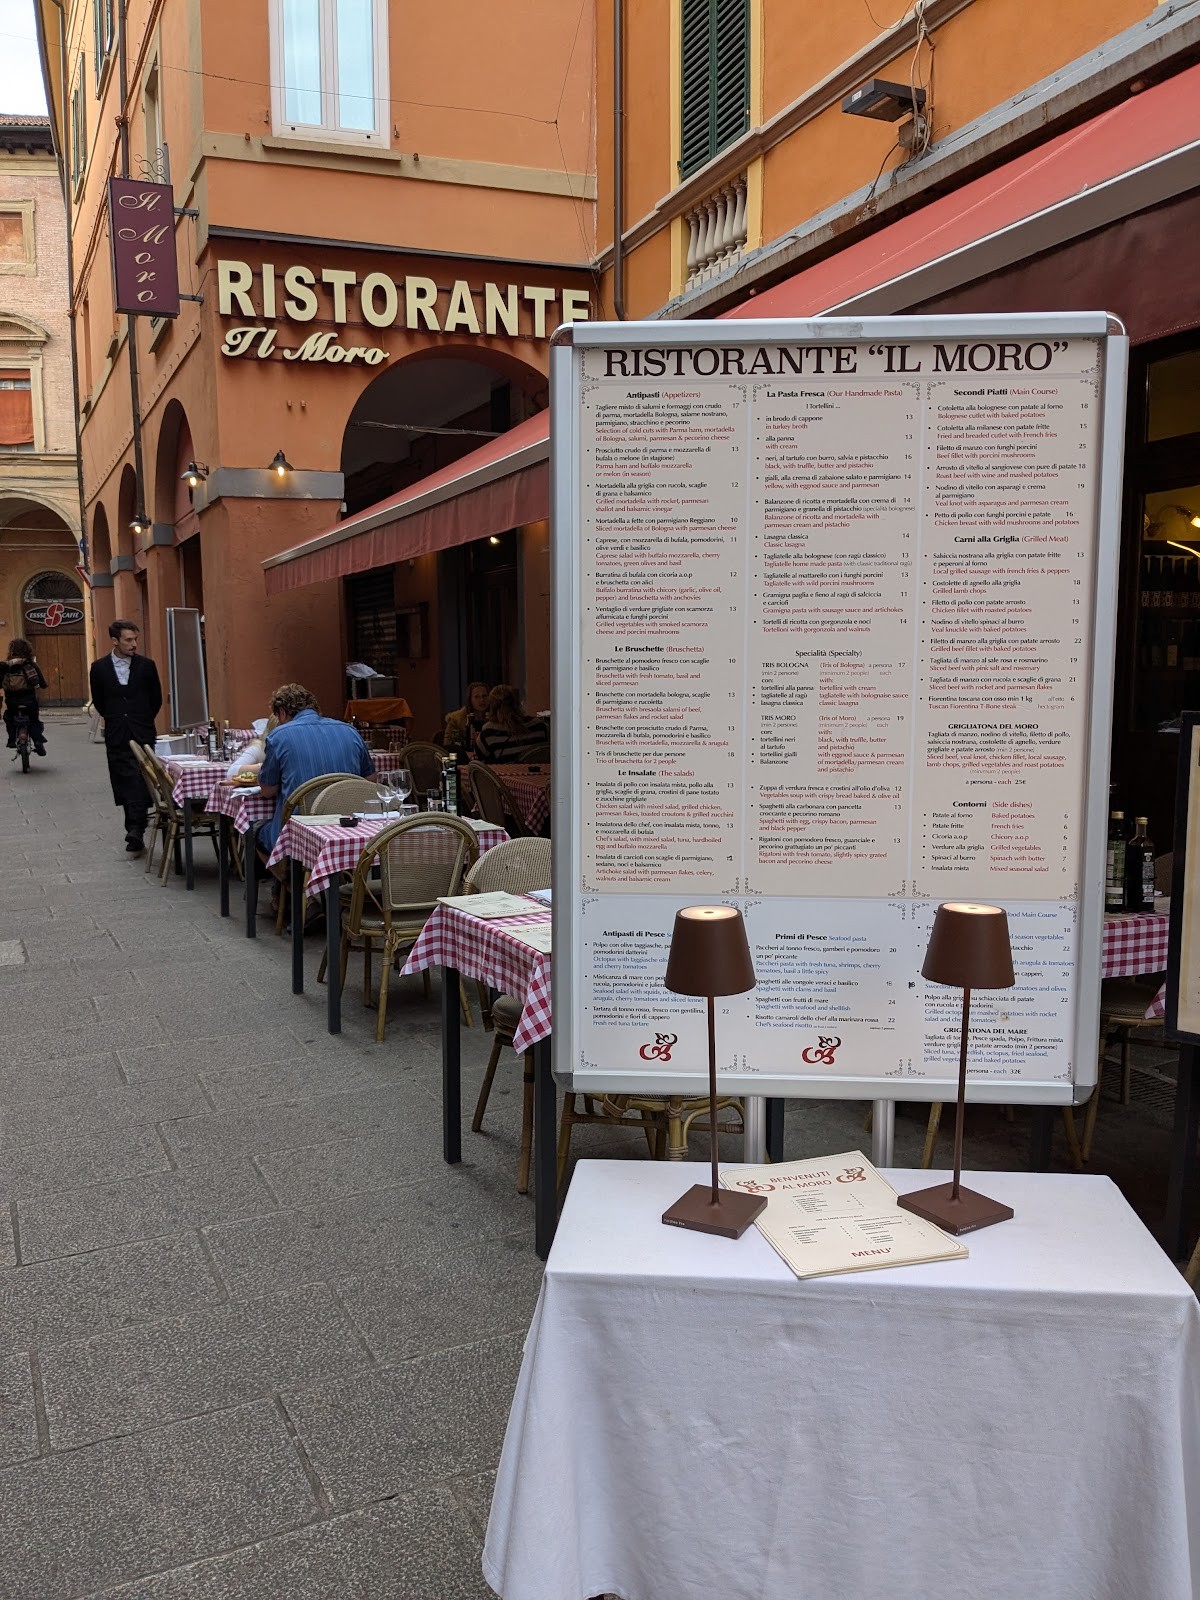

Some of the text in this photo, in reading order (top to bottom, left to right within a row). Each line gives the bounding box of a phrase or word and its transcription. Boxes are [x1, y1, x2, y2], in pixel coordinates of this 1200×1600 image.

[118, 192, 169, 302] Il Moro
[217, 260, 590, 338] RISTORANTE
[221, 326, 390, 365] Il Moro
[604, 346, 858, 376] RISTORANTE
[626, 391, 700, 400] Antipasti (Appetizers)
[993, 536, 1019, 544] Griglia
[795, 650, 862, 658] Specialità (Specialty)
[770, 1171, 830, 1183] BENVENUTI
[797, 1180, 832, 1188] MORO
